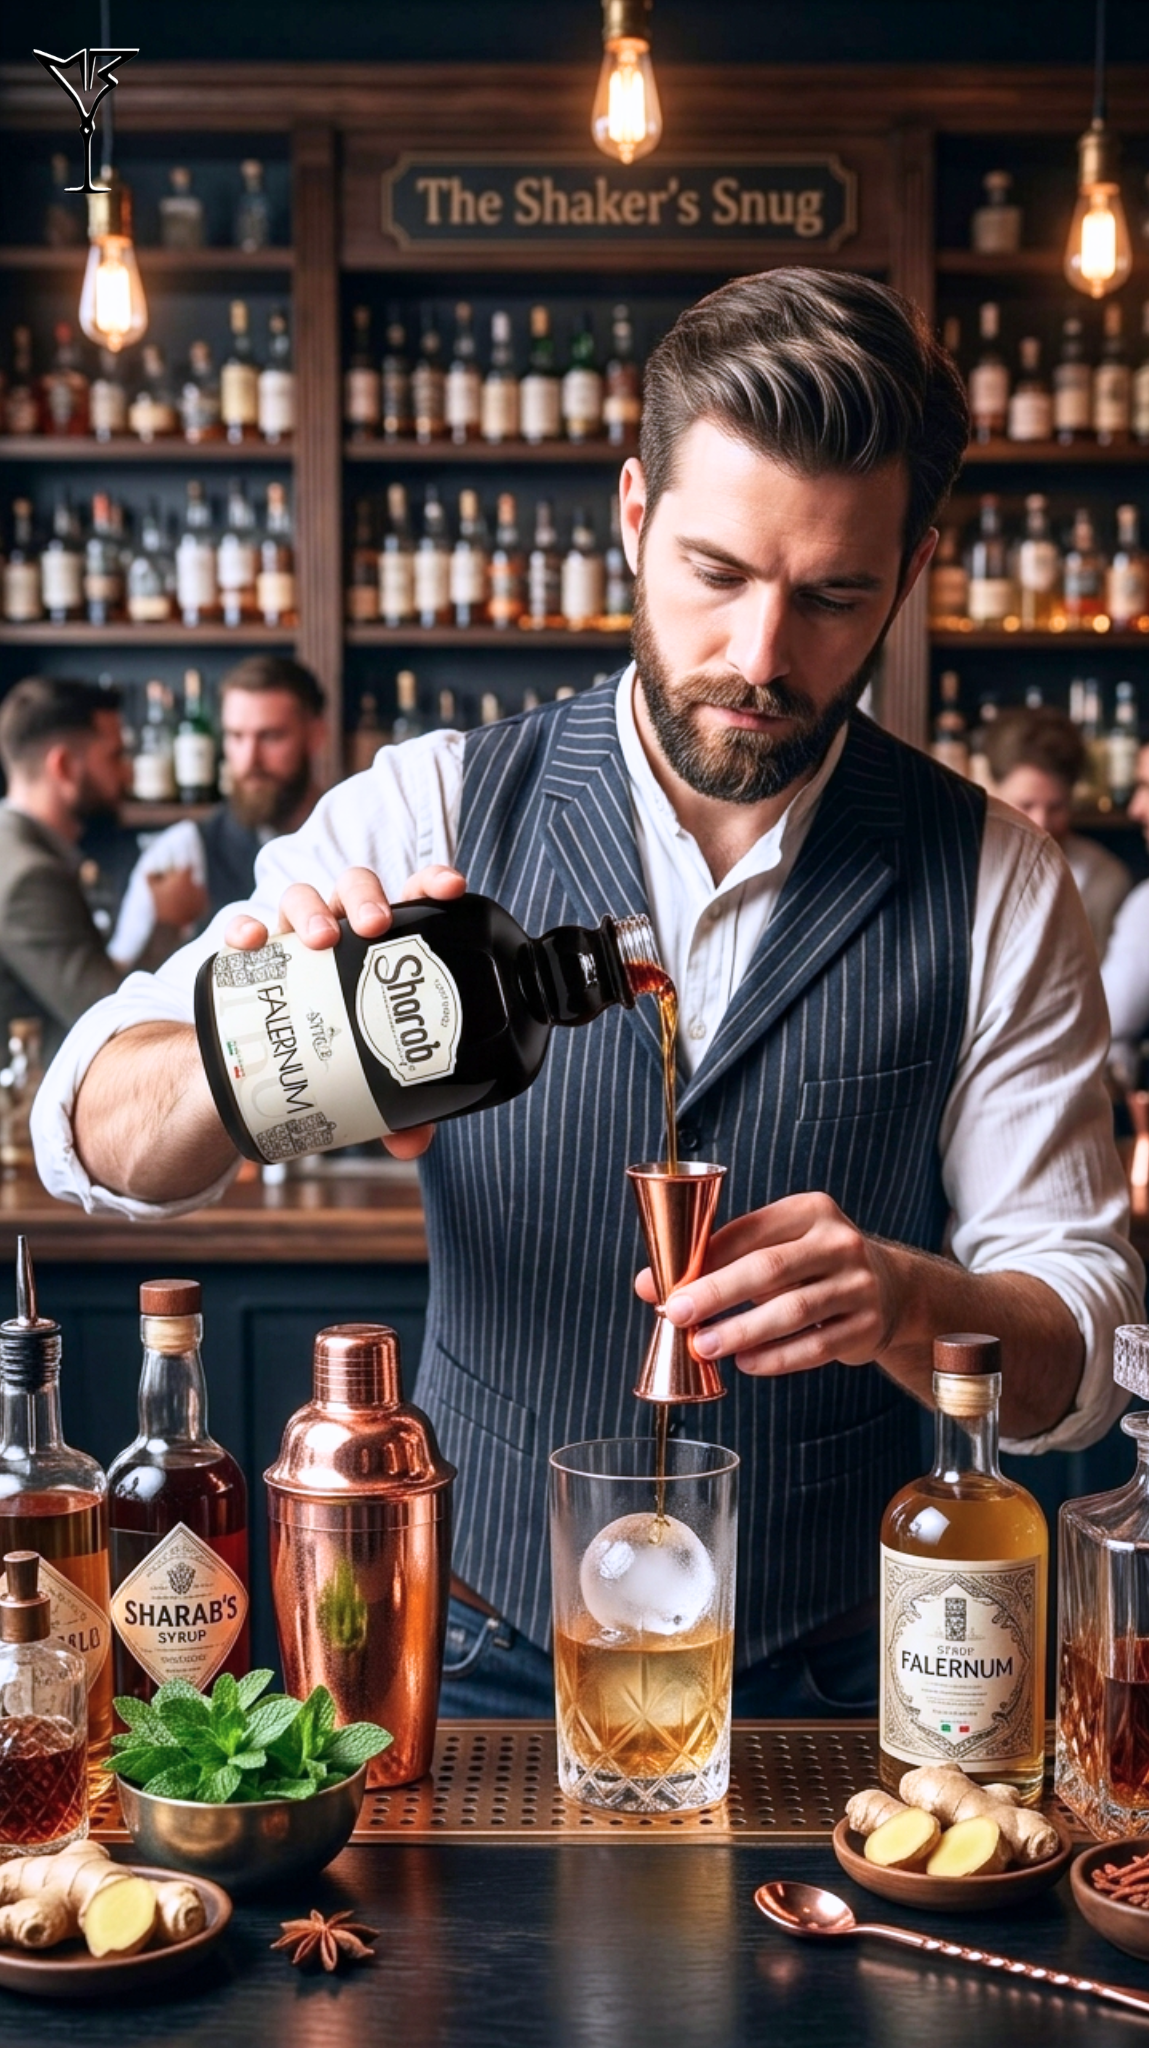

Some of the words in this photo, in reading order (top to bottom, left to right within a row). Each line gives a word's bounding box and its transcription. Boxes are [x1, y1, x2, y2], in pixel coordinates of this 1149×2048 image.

[416, 177, 502, 226] The
[514, 177, 700, 226] Shaker's
[712, 177, 824, 238] Snug
[374, 954, 441, 1065] Sharab
[257, 984, 314, 1115] FALERNUM
[125, 1594, 238, 1627] SHARAB'S
[158, 1629, 207, 1644] SYRUP
[901, 1650, 1013, 1678] FALERNUM
